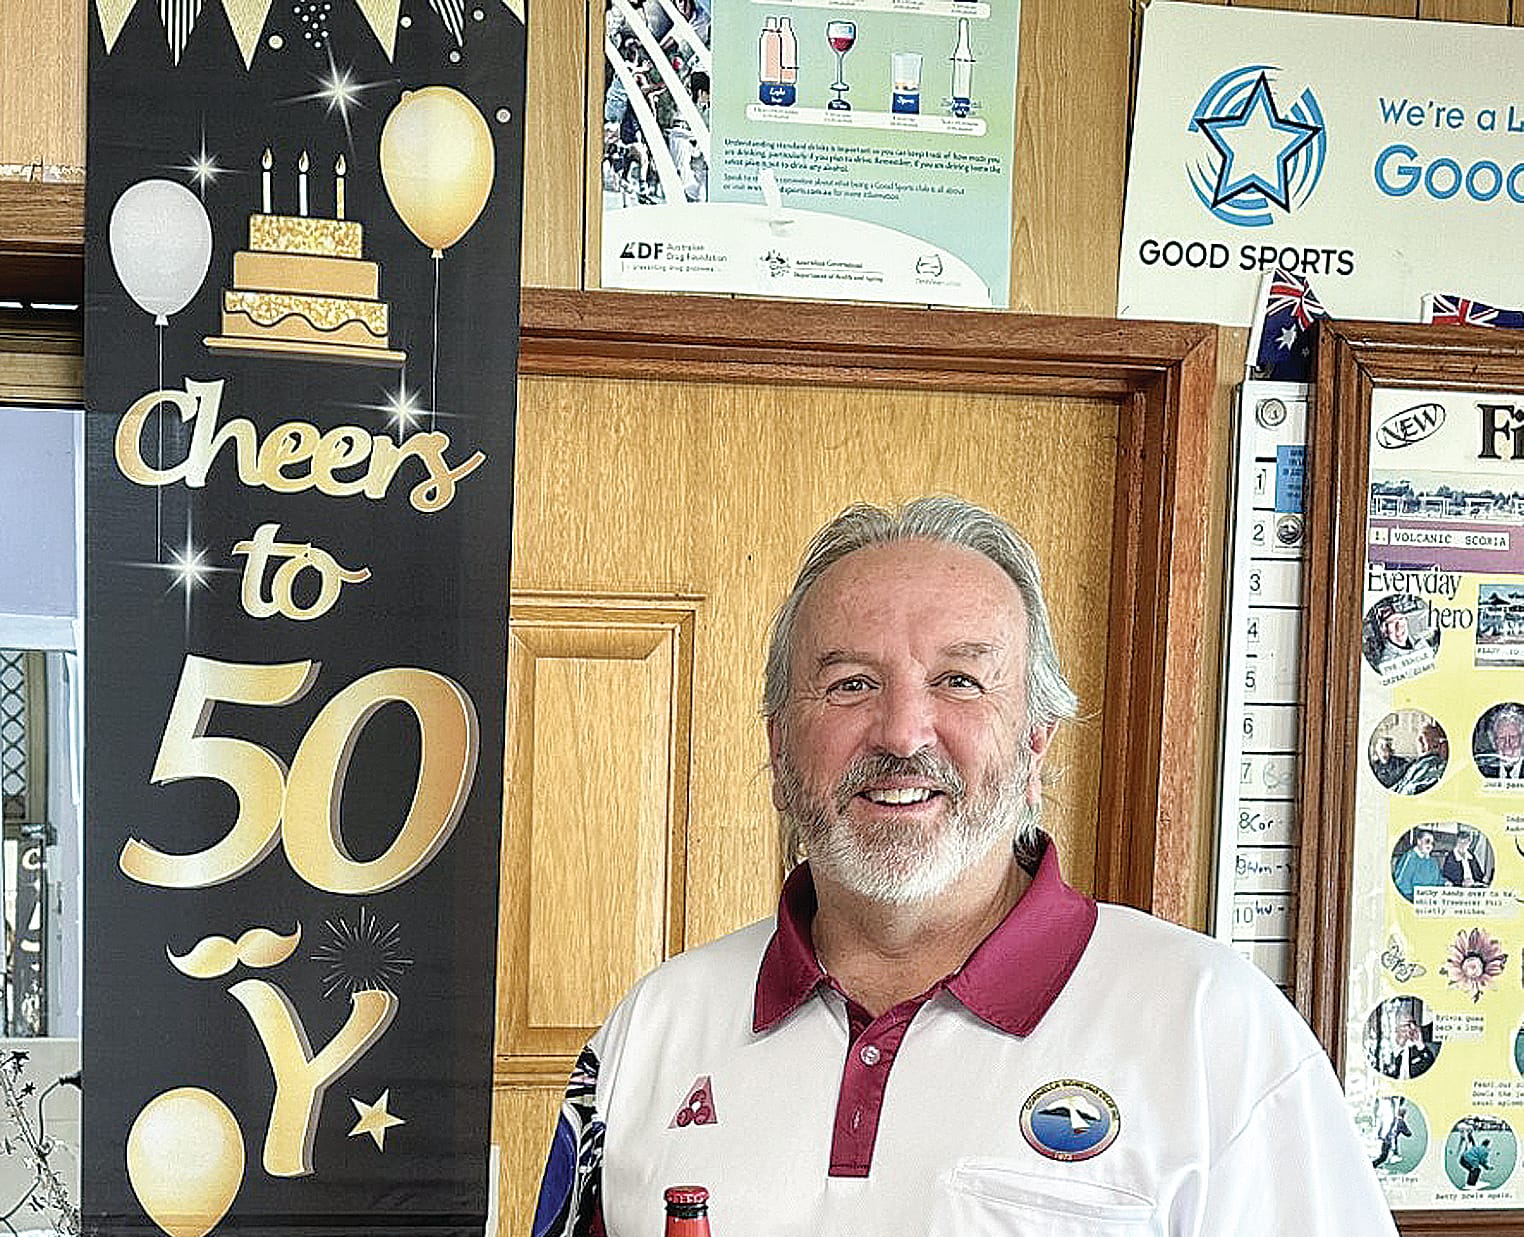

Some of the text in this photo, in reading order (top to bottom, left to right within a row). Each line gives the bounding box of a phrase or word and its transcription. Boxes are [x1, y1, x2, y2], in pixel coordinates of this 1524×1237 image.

[1379, 97, 1465, 129] We're
[1477, 107, 1495, 131] a
[874, 181, 894, 191] Good
[1139, 239, 1355, 277] GOOD SPORTS
[1380, 405, 1438, 446] NEW
[114, 377, 488, 514] Cheers
[1252, 523, 1264, 541] 2
[1394, 532, 1453, 545] VOLCANIC
[1465, 535, 1507, 547] SCORIA
[231, 523, 373, 621] to
[1250, 574, 1261, 592] 3
[1367, 563, 1463, 601] Everyday
[1427, 599, 1473, 629] hero
[1247, 621, 1258, 638] 4
[1244, 670, 1256, 688] 5
[1243, 717, 1254, 735] 6
[119, 653, 480, 895] 50
[1242, 762, 1251, 780] 7
[1239, 811, 1250, 829] 8
[1234, 906, 1254, 924] 10
